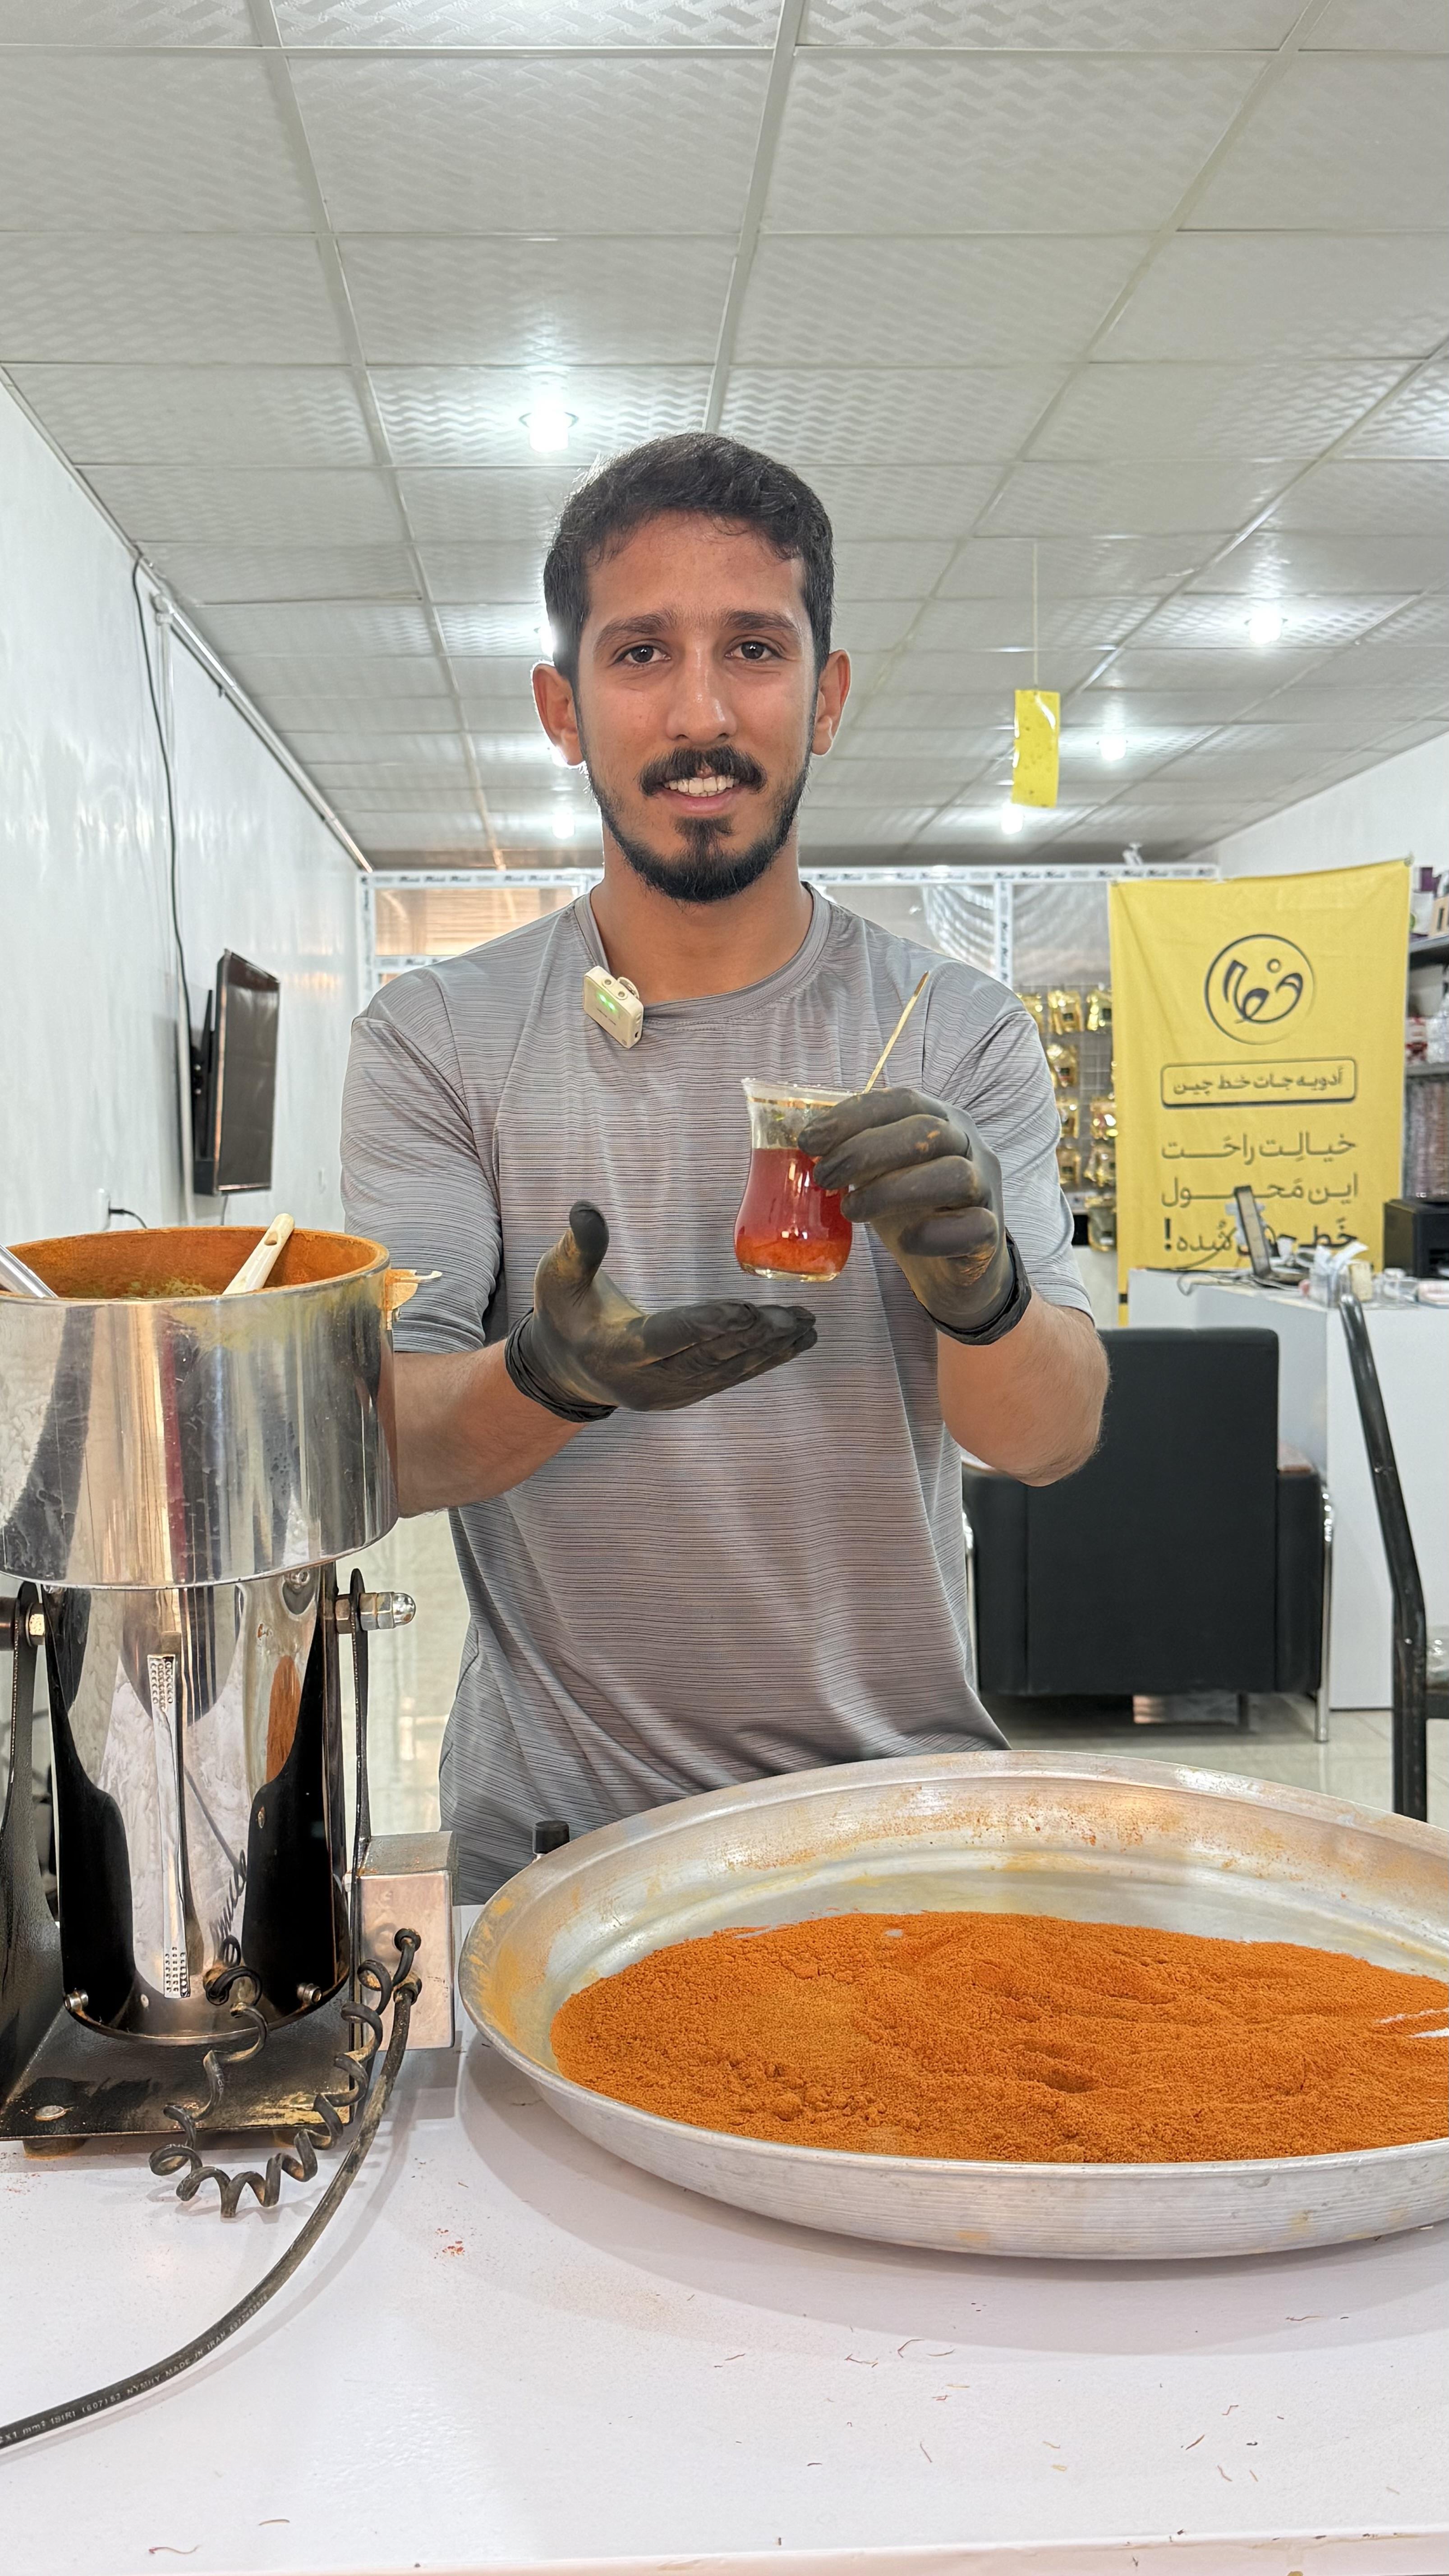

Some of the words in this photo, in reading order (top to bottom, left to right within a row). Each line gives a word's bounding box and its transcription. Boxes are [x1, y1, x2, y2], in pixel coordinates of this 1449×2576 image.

[1172, 1079, 1214, 1096] چین
[1217, 1074, 1251, 1090] خط
[1253, 1072, 1294, 1090] جات
[1308, 1173, 1358, 1205] این
[165, 2358, 191, 2377] MADE
[194, 2348, 203, 2359] IN
[207, 2331, 226, 2351] IRAN
